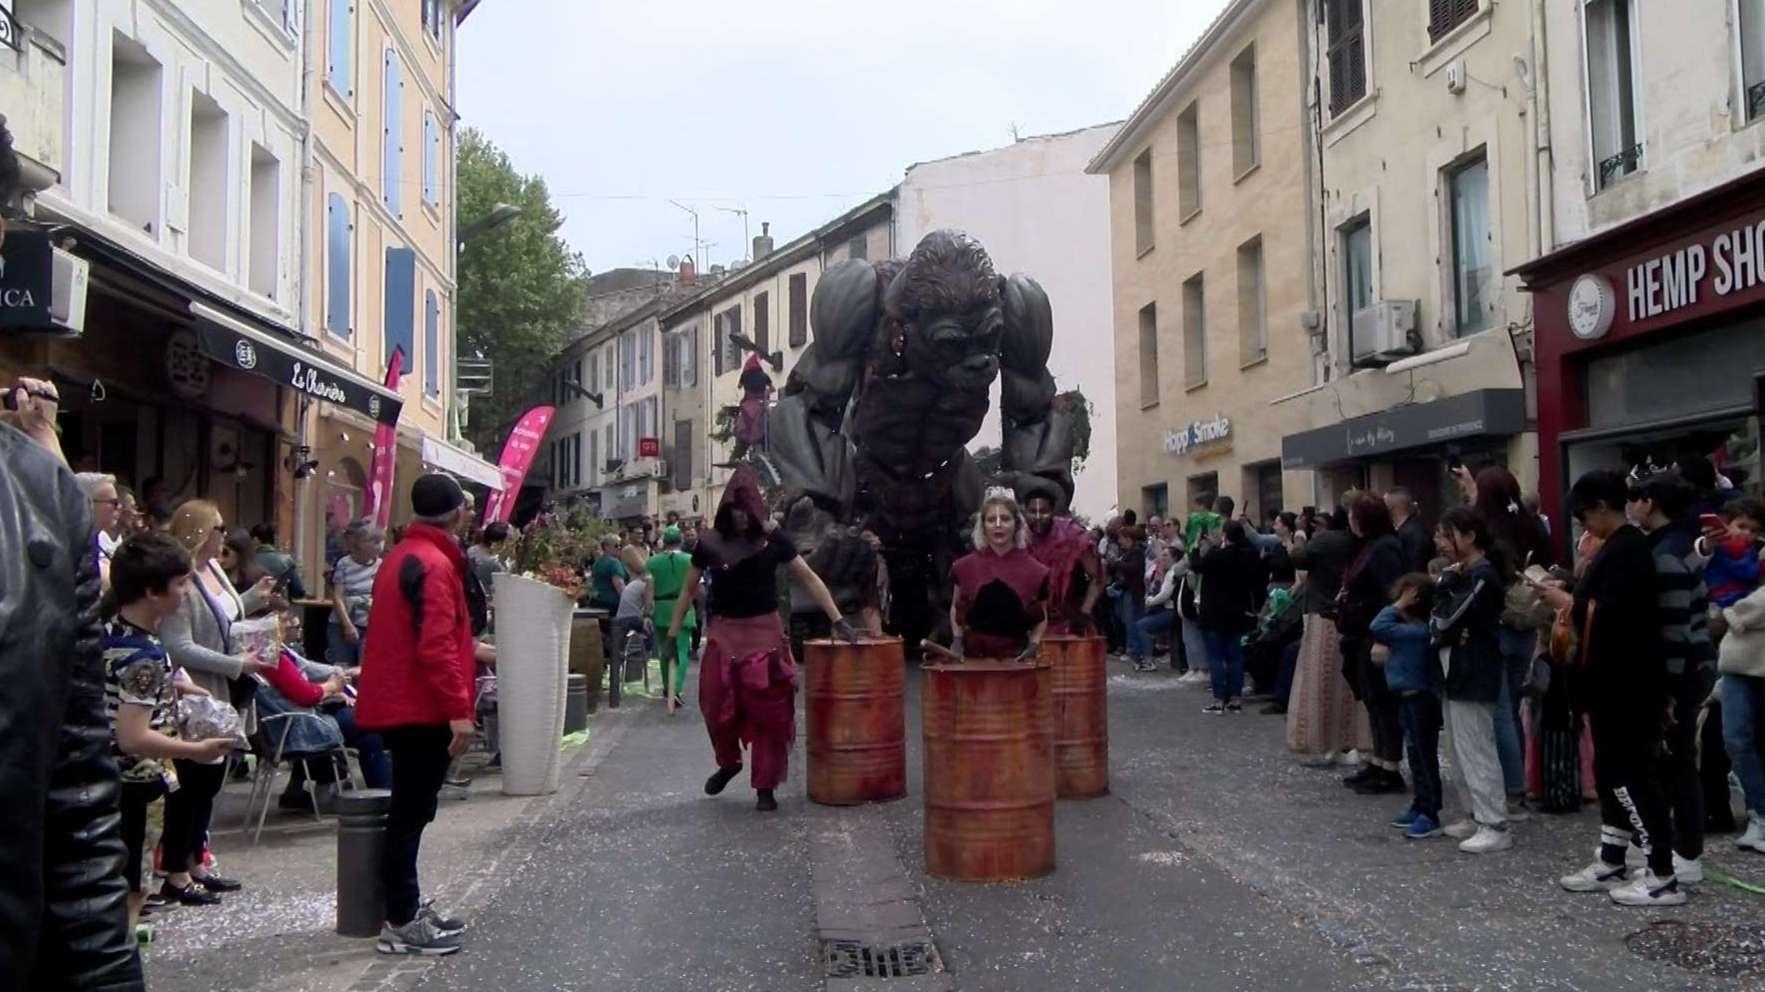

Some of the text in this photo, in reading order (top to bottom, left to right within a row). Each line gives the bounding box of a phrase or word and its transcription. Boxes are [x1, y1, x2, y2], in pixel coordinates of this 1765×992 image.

[1627, 243, 1706, 322] HEMP
[1160, 413, 1229, 455] Happ Smoke
